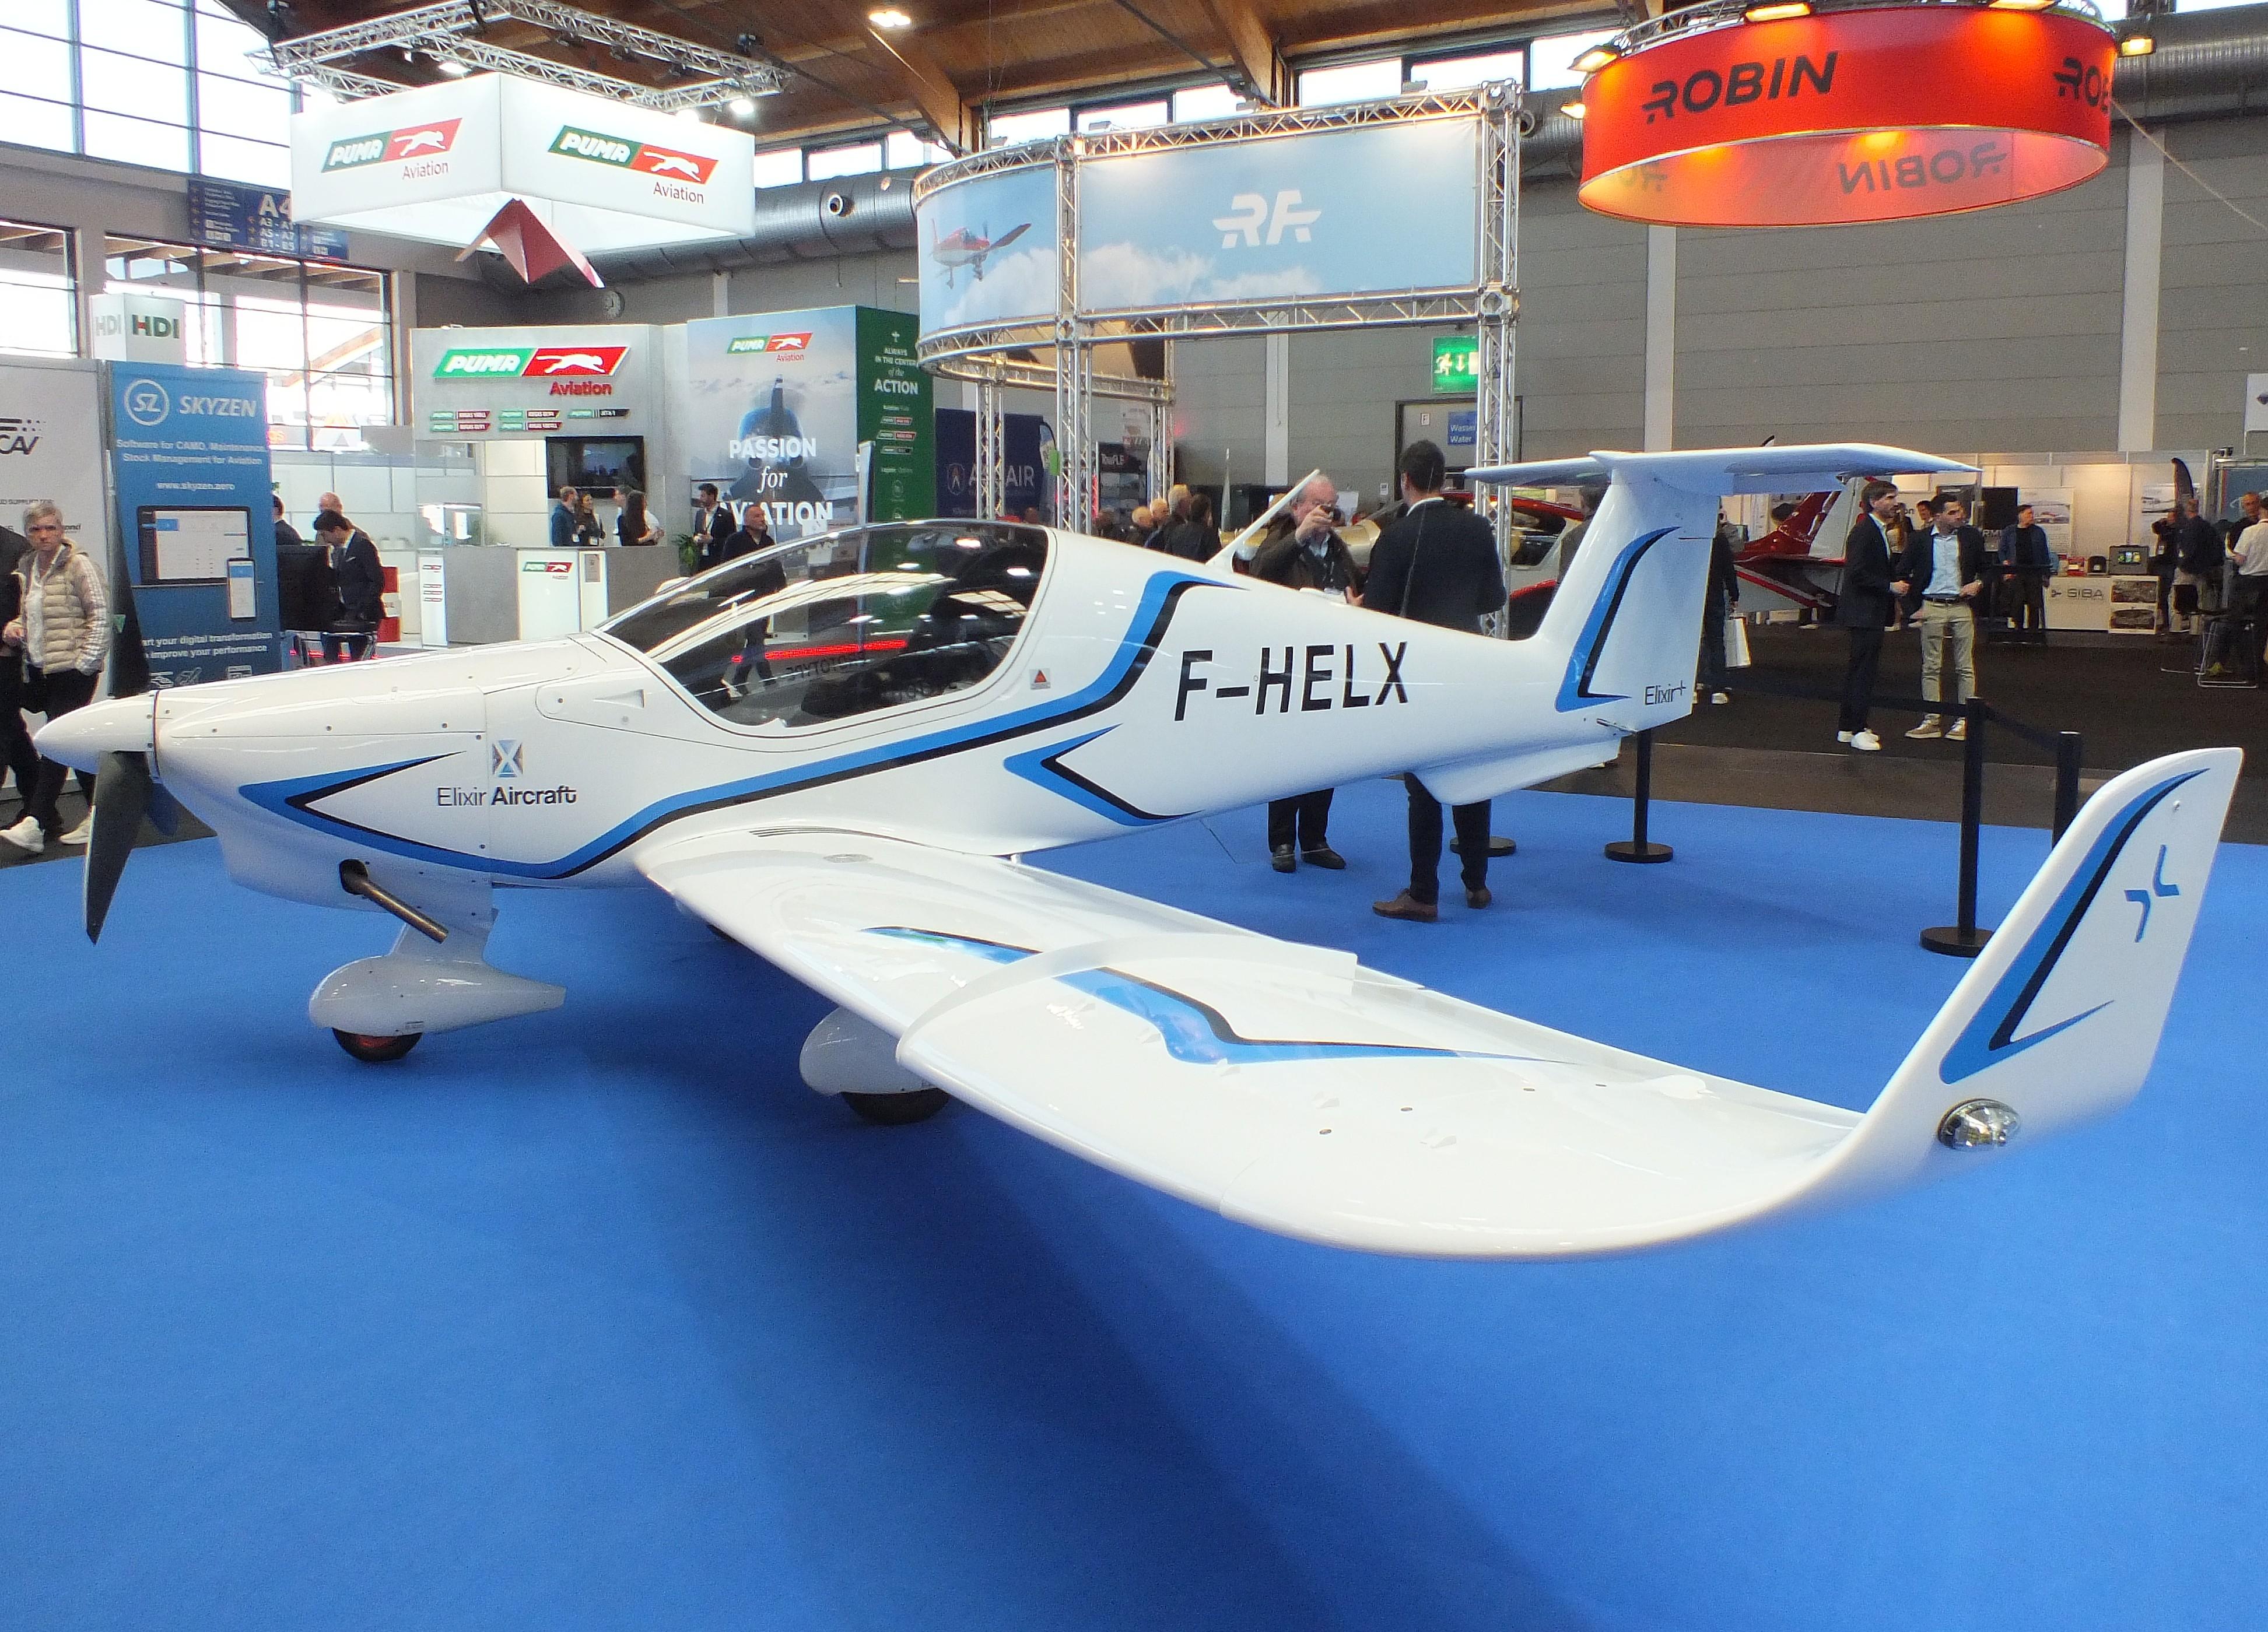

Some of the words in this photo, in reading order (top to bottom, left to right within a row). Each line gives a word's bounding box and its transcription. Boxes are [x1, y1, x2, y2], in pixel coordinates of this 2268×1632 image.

[1642, 51, 1838, 124] ROBIN
[2054, 57, 2109, 113] ROB
[328, 139, 383, 166] PUMA
[560, 131, 631, 163] PUMA
[402, 160, 449, 180] Aviation
[653, 181, 704, 204] Aviation
[96, 314, 121, 336] HDI
[132, 314, 180, 339] HDI
[731, 339, 765, 352] PUMA
[445, 355, 521, 373] PUMA
[776, 354, 804, 362] Aviation
[550, 380, 612, 396] Aviation
[874, 378, 919, 395] ACTION
[179, 395, 257, 417] SKYZEN
[161, 440, 174, 450] for
[730, 438, 816, 459] PASSION
[122, 453, 150, 462] Stock
[227, 456, 262, 465] Aviation
[756, 465, 788, 493] for
[720, 501, 833, 525] VATION
[2067, 588, 2103, 598] SIBA
[156, 638, 177, 647] your
[180, 635, 207, 646] digital
[150, 649, 188, 660] improve
[190, 648, 211, 658] your
[213, 644, 267, 657] performance
[1175, 641, 1407, 721] F-HELX
[437, 786, 486, 806] Elixir
[491, 785, 577, 806] Aircraft
